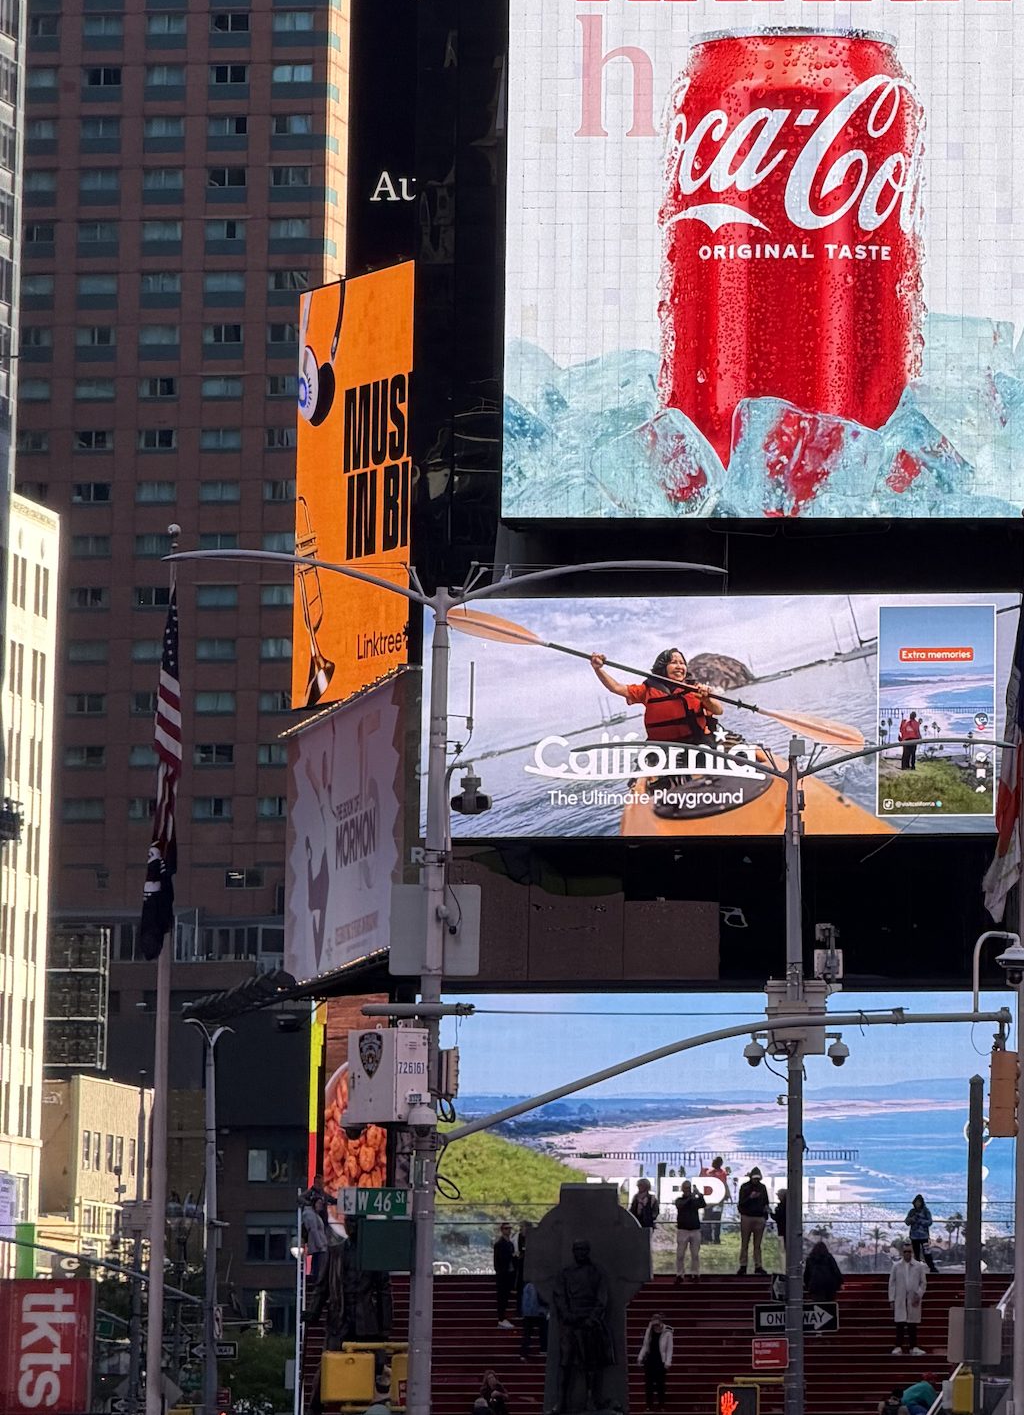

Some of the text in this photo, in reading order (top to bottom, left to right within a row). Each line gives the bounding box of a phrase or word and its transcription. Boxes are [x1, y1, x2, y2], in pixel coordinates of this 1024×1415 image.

[698, 244, 892, 260] ORIGINAL TASTE
[345, 469, 378, 561] IN
[901, 649, 972, 660] Extra memories
[531, 729, 763, 778] California
[547, 788, 744, 809] The Ultimate Playground
[335, 807, 376, 871] MORMON
[358, 1191, 405, 1212] W 46 St
[766, 1313, 786, 1325] ON
[18, 1287, 77, 1409] tkts
